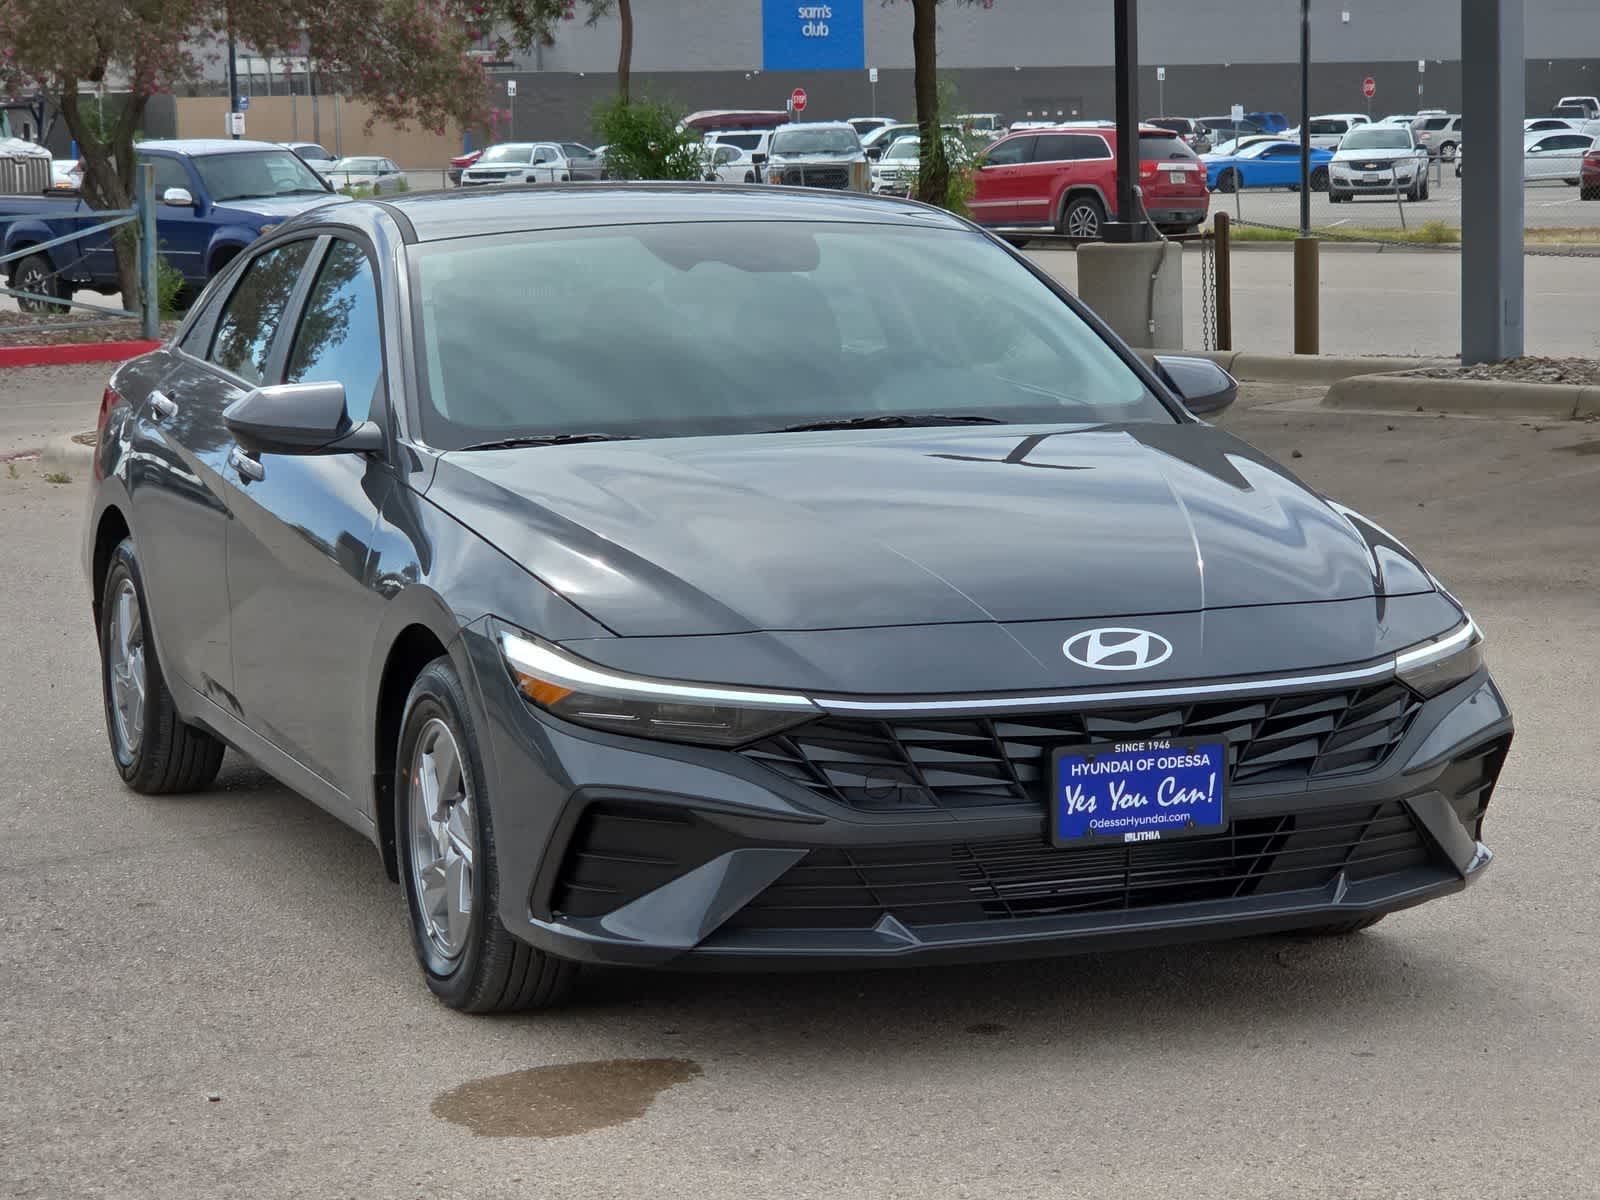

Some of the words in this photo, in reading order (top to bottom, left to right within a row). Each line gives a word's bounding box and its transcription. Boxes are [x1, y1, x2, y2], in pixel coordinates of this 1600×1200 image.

[798, 5, 832, 19] sam's
[802, 21, 829, 37] club
[1115, 742, 1145, 753] SINCE
[1148, 740, 1171, 751] 1946
[1071, 759, 1133, 776] HYUNDAI
[1136, 758, 1155, 771] OF
[1157, 754, 1210, 770] ODESSA
[1065, 783, 1097, 815] Yes
[1108, 779, 1149, 812] You
[1156, 772, 1216, 807] Can!
[1089, 812, 1191, 830] OdessaHyundai.com
